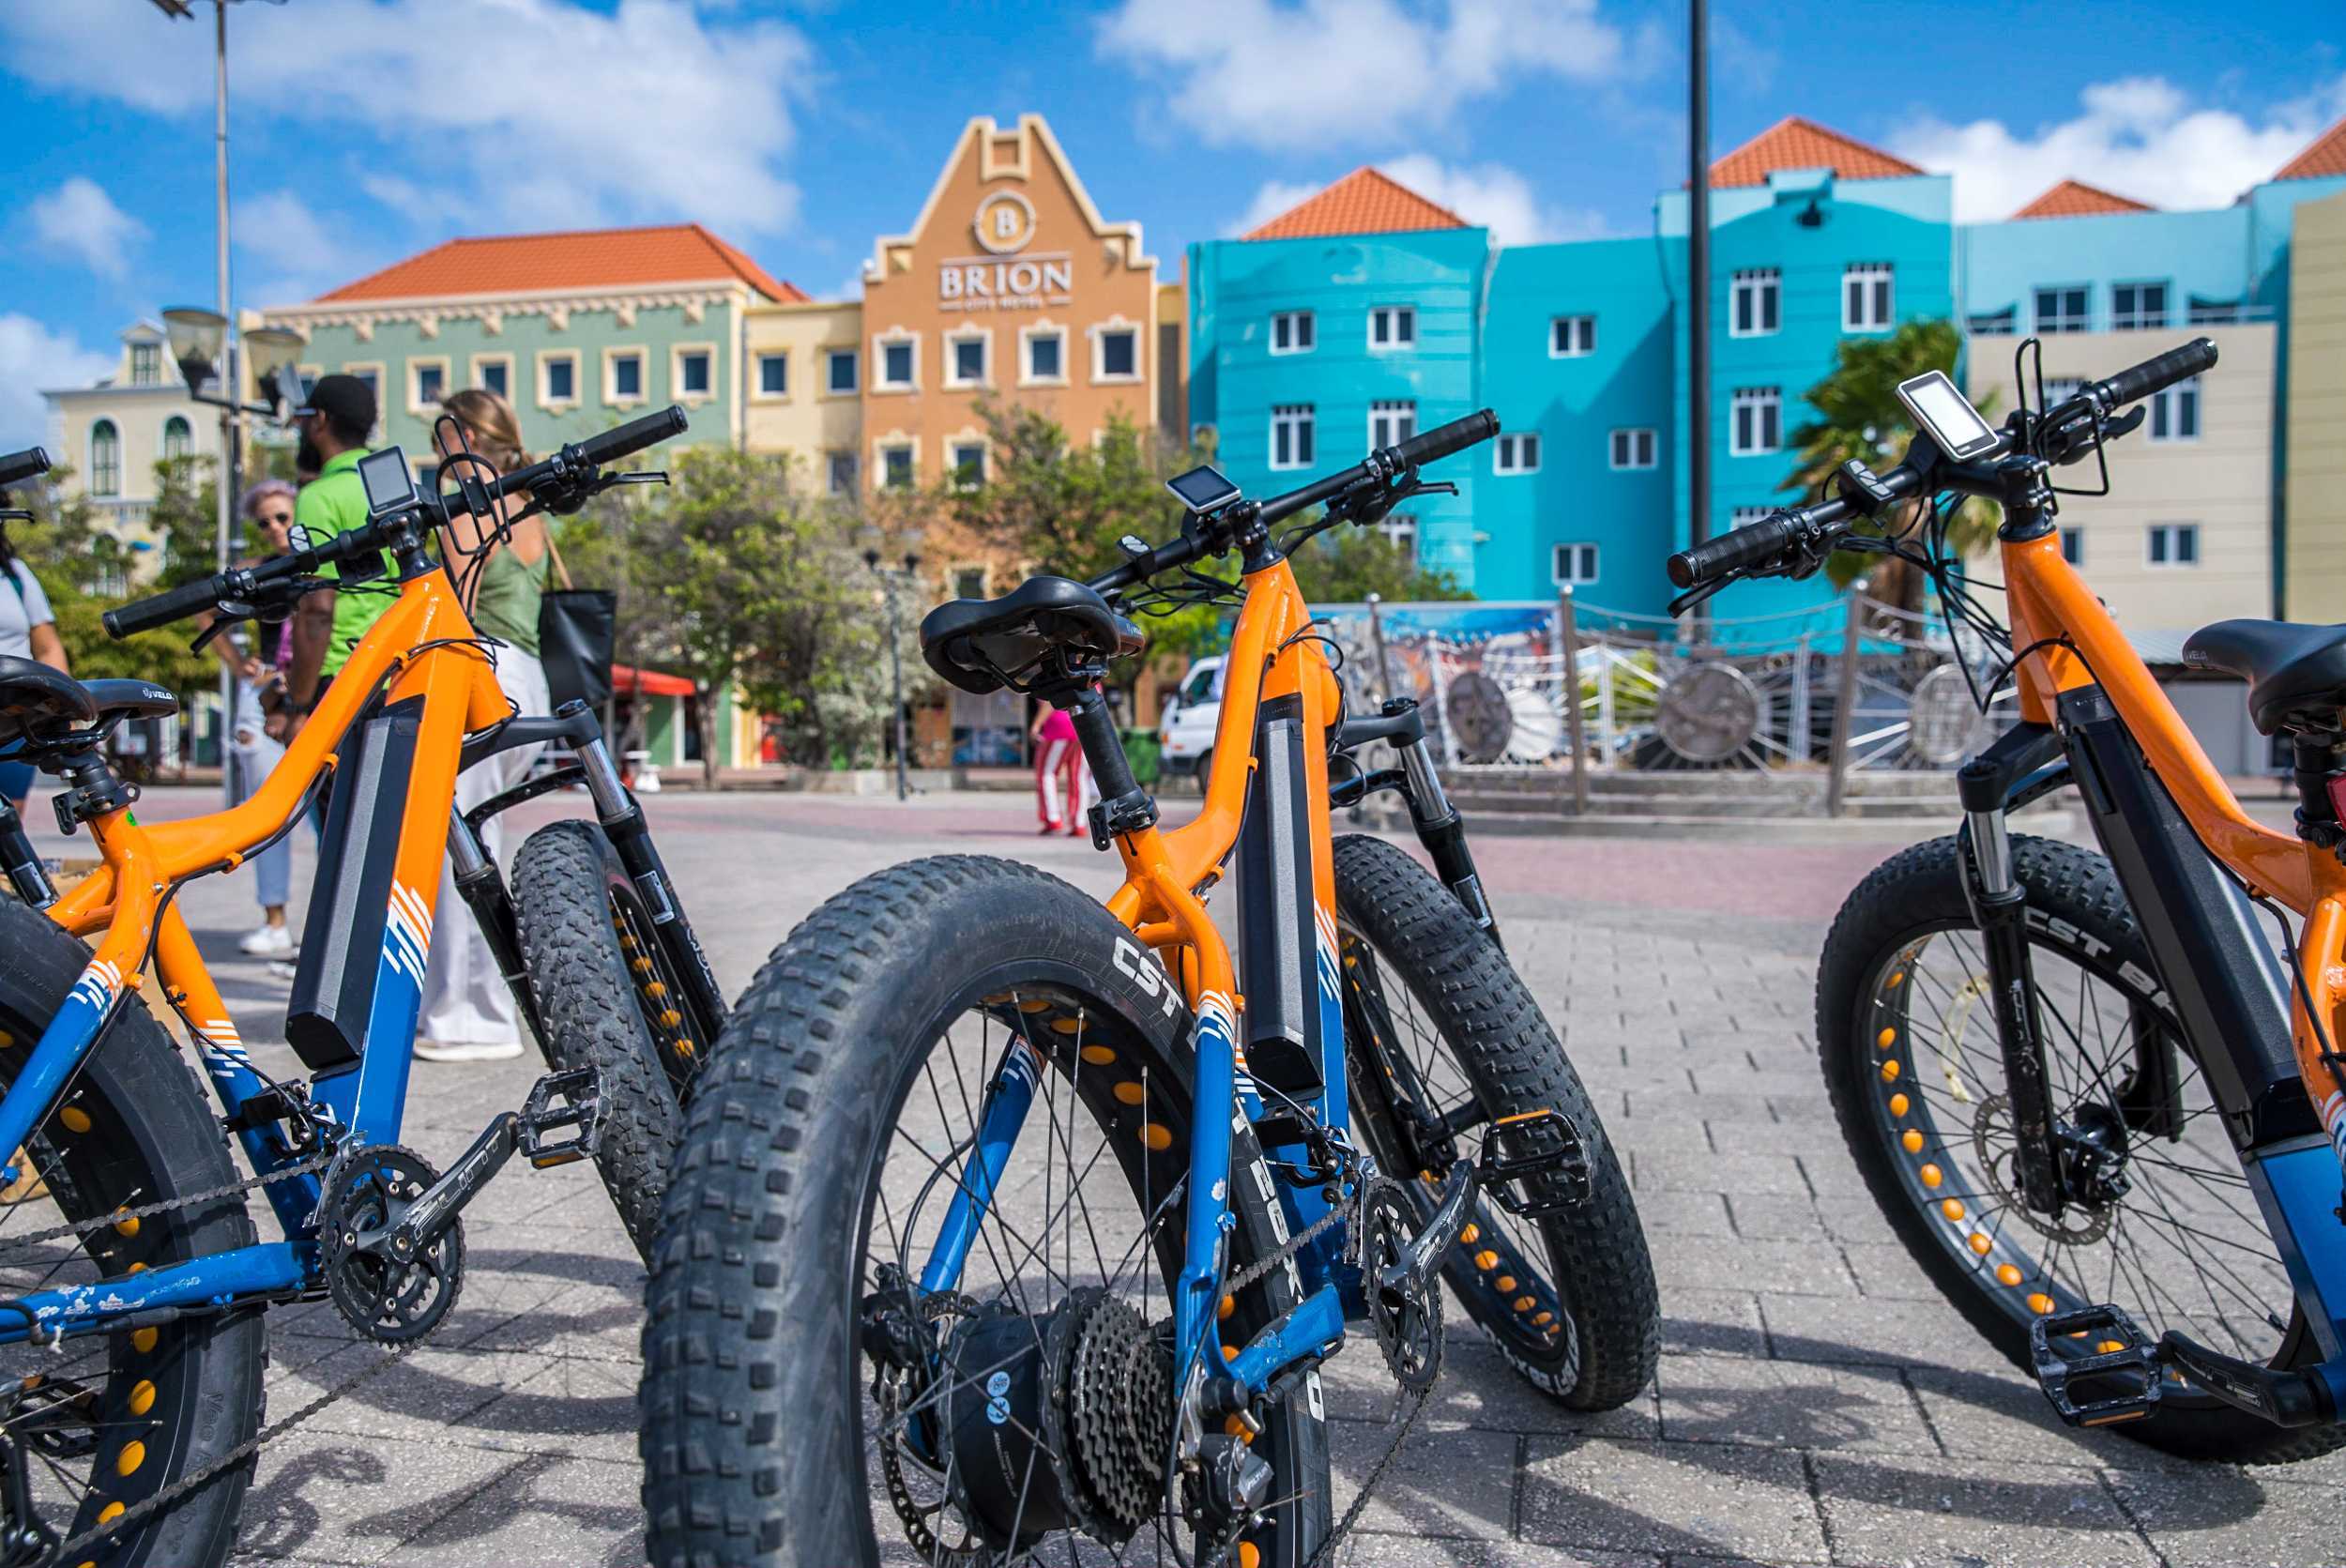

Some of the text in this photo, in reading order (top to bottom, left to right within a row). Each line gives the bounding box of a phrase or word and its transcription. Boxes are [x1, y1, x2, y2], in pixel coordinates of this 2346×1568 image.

[995, 207, 1018, 237] B
[940, 262, 1073, 299] BRION
[2024, 906, 2111, 958] CST
[1112, 936, 1184, 1018] CST
